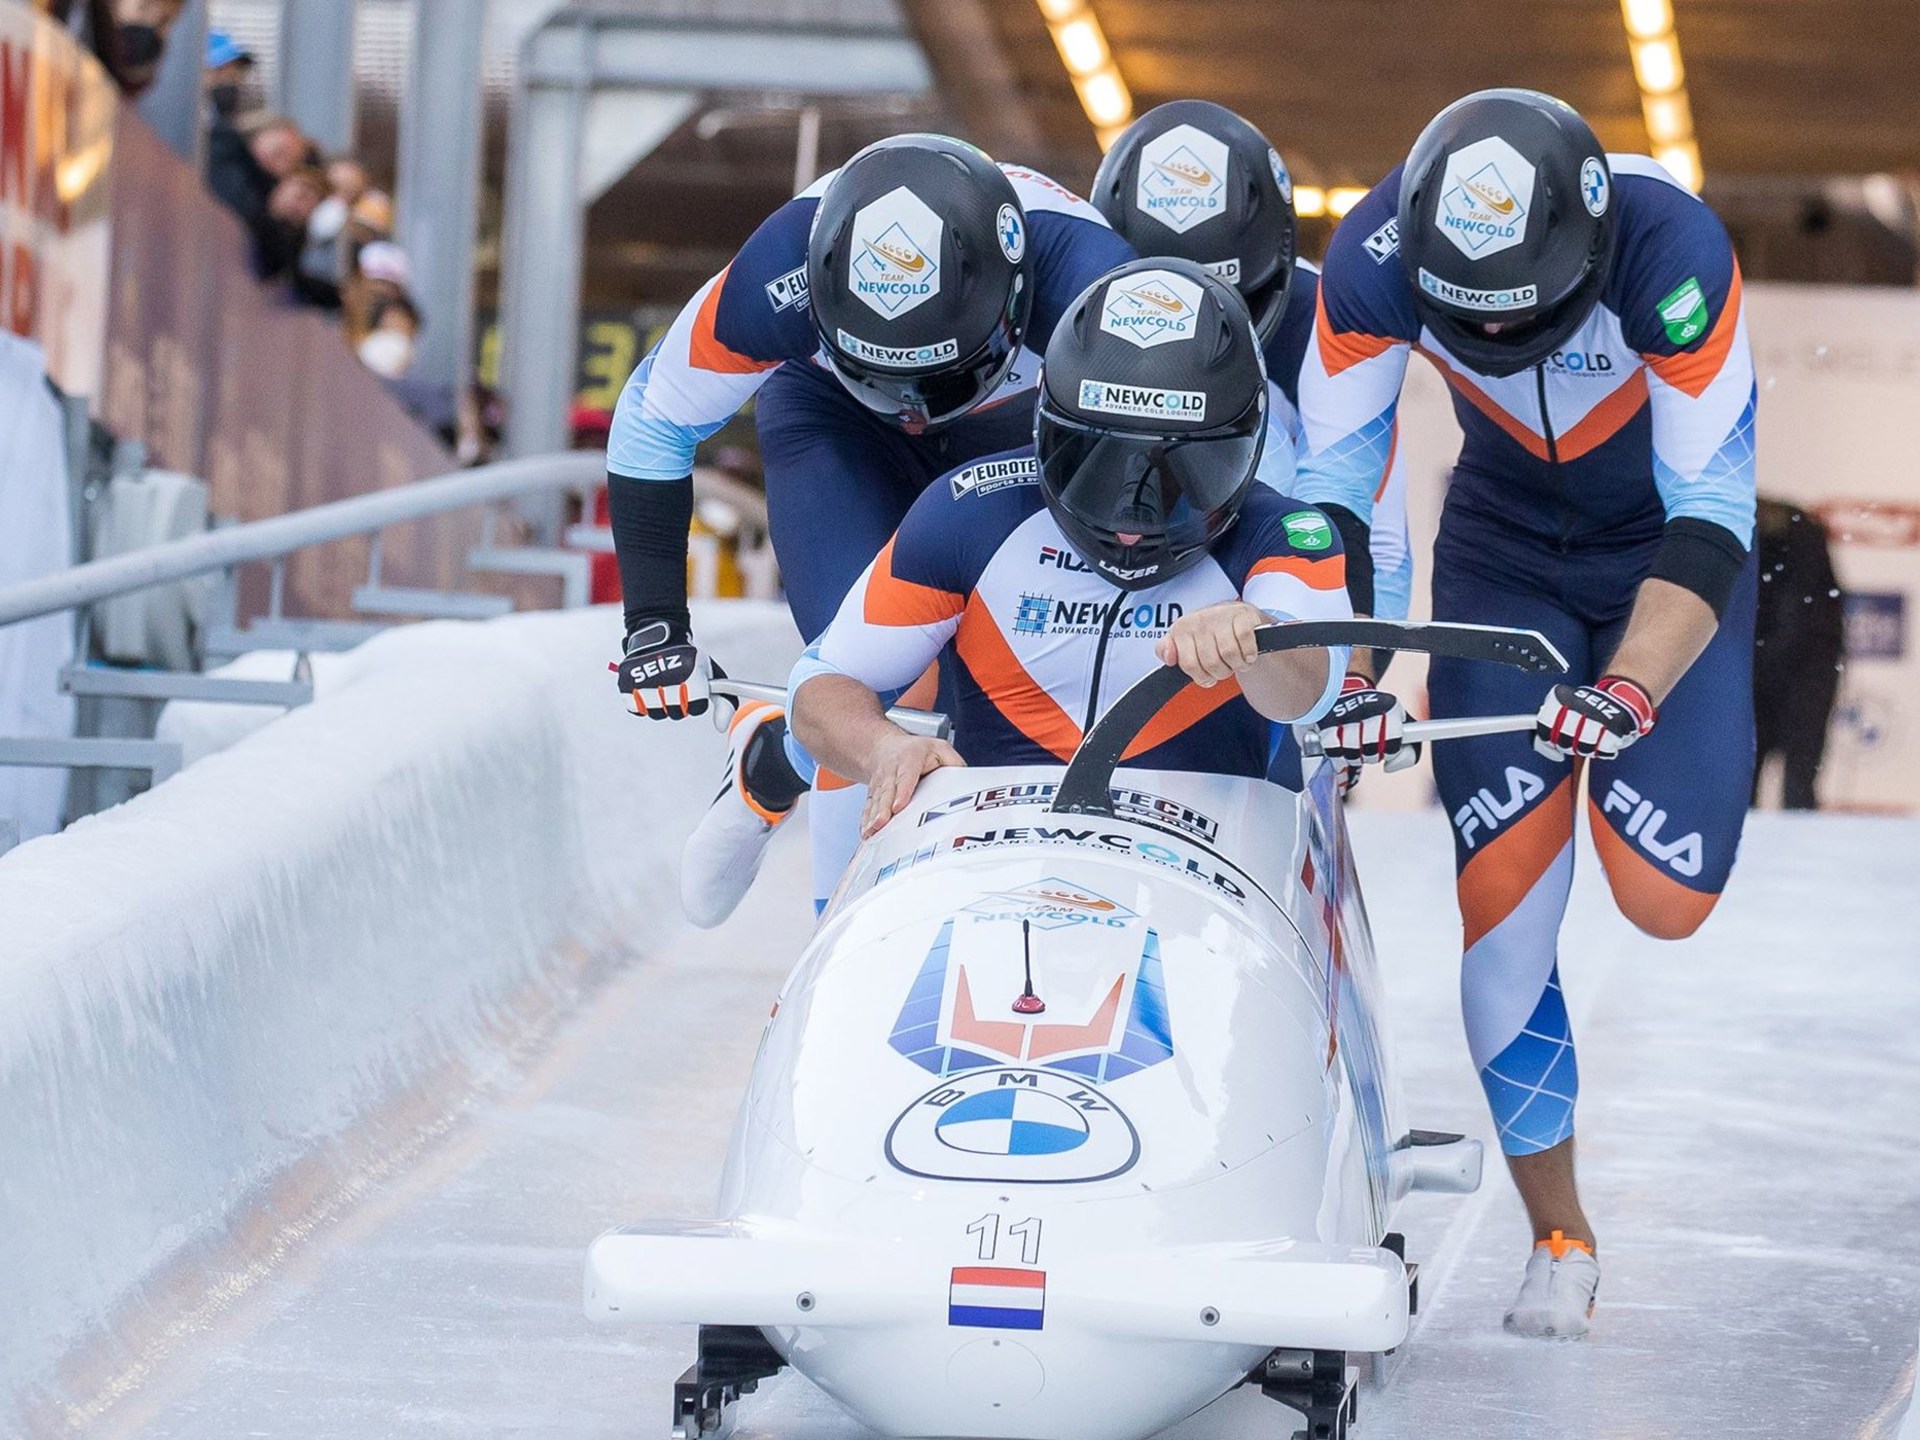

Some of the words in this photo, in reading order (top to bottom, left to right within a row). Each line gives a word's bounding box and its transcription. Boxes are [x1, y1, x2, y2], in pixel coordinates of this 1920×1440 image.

[1147, 197, 1217, 208] NEWCOLD
[1445, 215, 1516, 238] NEWCOLD
[858, 281, 930, 294] NEWCOLD
[1441, 284, 1534, 304] NEWCOLD
[1111, 316, 1186, 331] NEWCOLD
[861, 343, 955, 361] NEWCOLD
[1105, 387, 1204, 411] NEWCOLD
[1105, 403, 1142, 413] ADVANCED
[1144, 407, 1164, 415] COLD
[1166, 410, 1203, 418] LOGISTICS
[1099, 560, 1159, 580] LAZER
[1051, 627, 1100, 636] ADVANCED
[1108, 631, 1131, 639] COLD
[630, 655, 682, 684] SEIZ
[1333, 693, 1378, 717] SEIZ
[1574, 689, 1621, 720] SEIZ
[1454, 766, 1545, 849] FILA
[1603, 779, 1702, 877] FILA
[953, 827, 1246, 899] NEWCOLD
[974, 911, 1126, 928] NEWCOLD
[924, 1073, 1110, 1111] BMW
[966, 1213, 1042, 1264] 11
